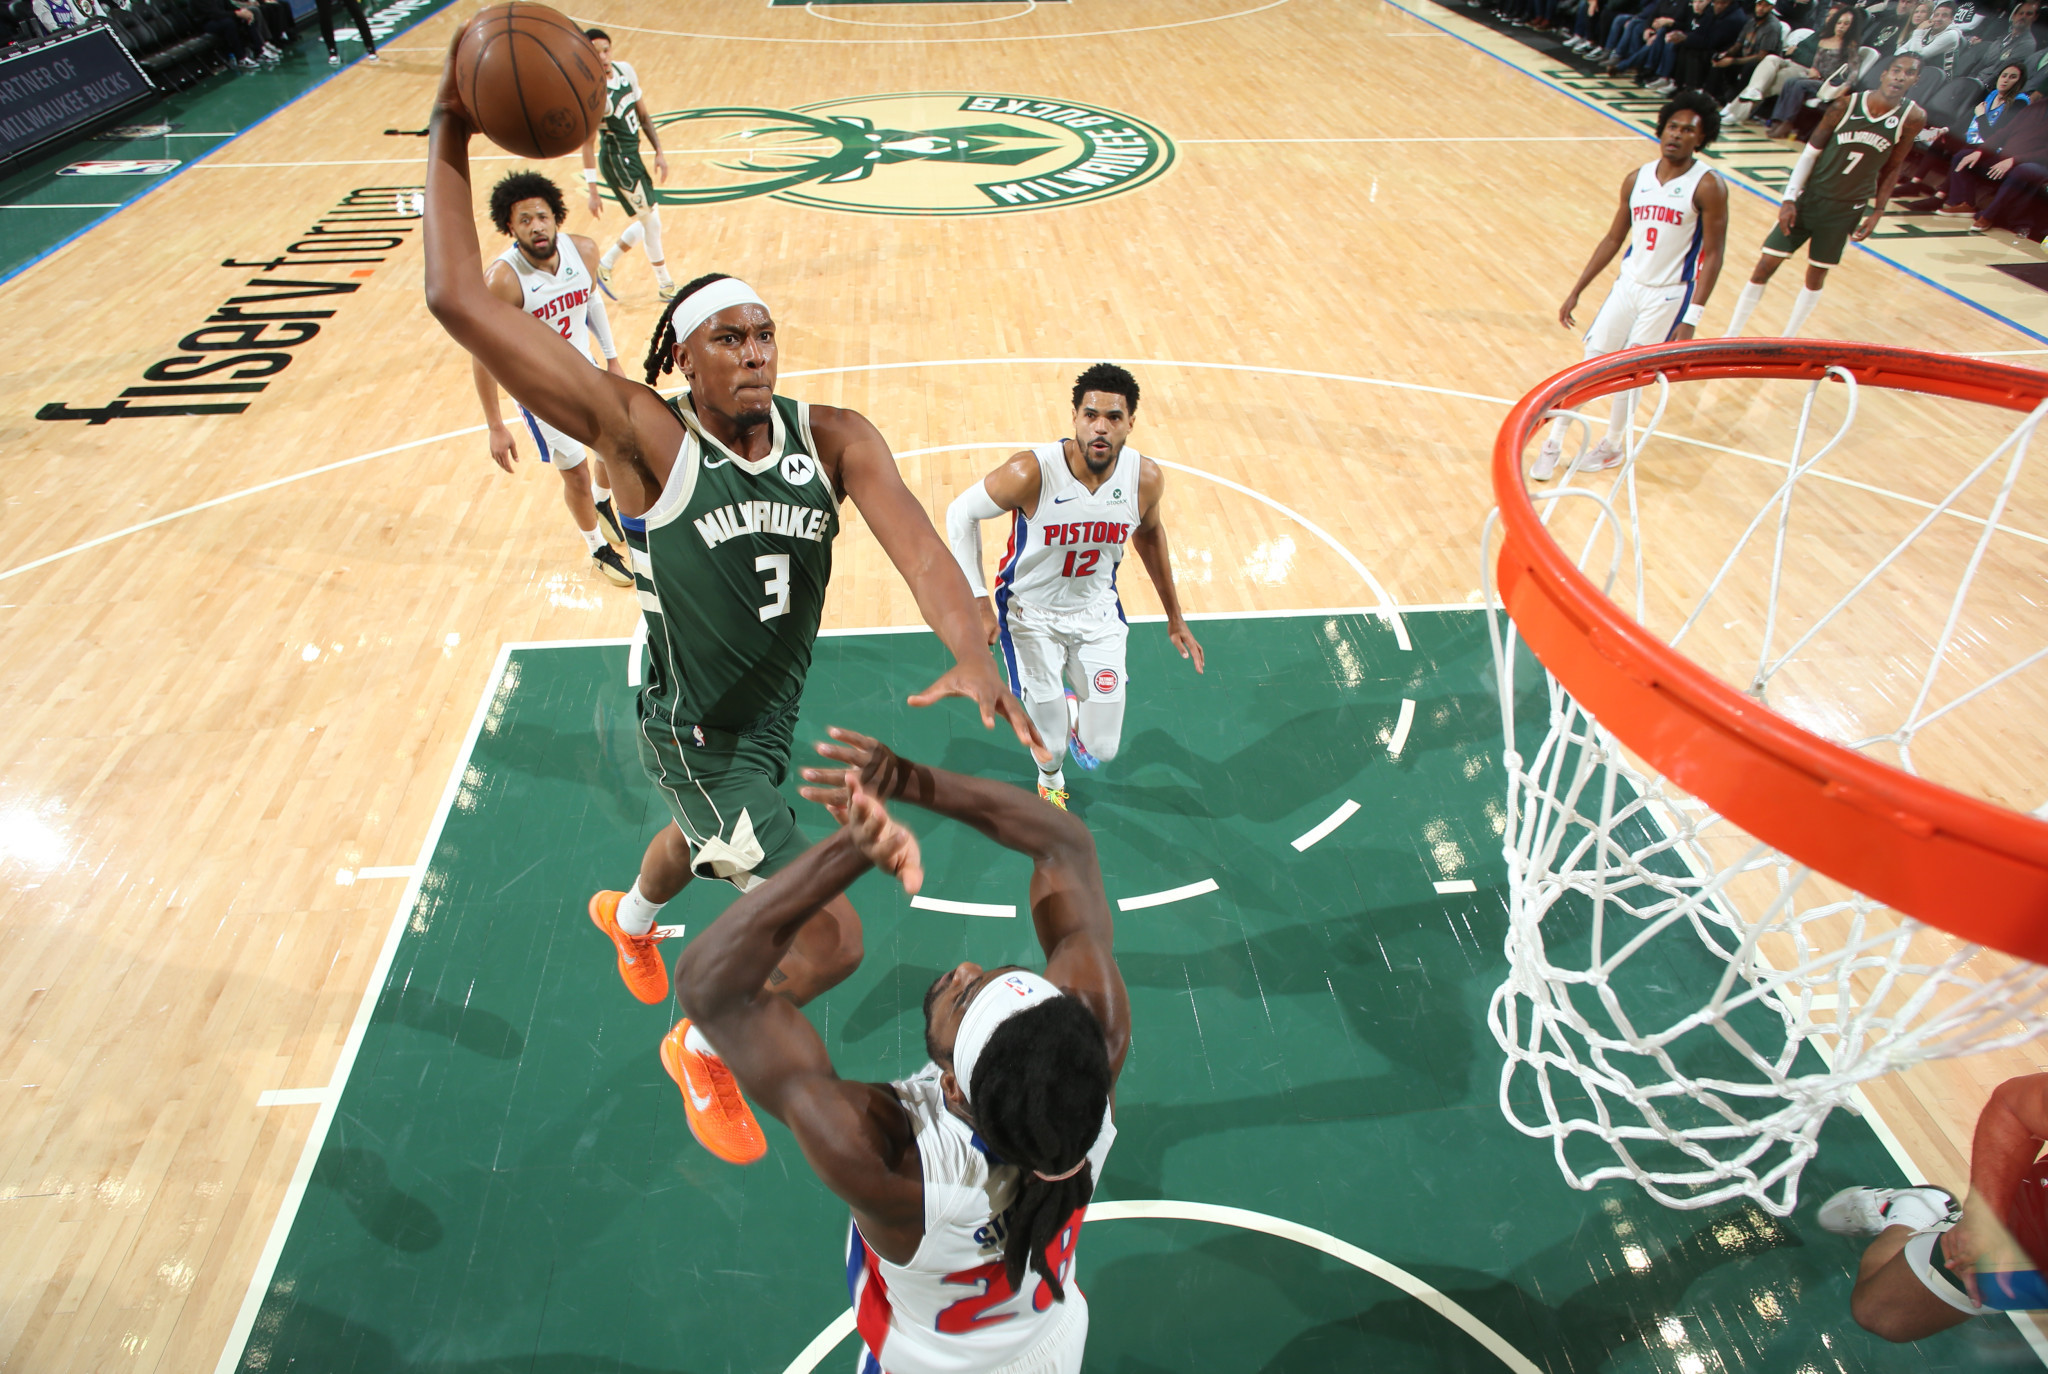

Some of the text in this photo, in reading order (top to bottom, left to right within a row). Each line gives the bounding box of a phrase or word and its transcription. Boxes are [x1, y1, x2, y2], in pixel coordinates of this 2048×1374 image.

[53, 58, 77, 80] OF
[0, 72, 131, 142] MILWAUKEE BUCKS
[967, 97, 1149, 204] MILWAUKEE BUCKS
[1837, 131, 1892, 161] MILWAUKEE
[1841, 151, 1864, 175] 7
[1633, 205, 1685, 226] PISTONS
[1645, 227, 1659, 251] 9
[532, 288, 589, 320] PISTONS
[557, 316, 573, 339] 2
[693, 500, 830, 550] MILWAUKEE
[1043, 521, 1129, 546] PISTONS
[1062, 549, 1100, 578] 12
[755, 553, 791, 622] 3
